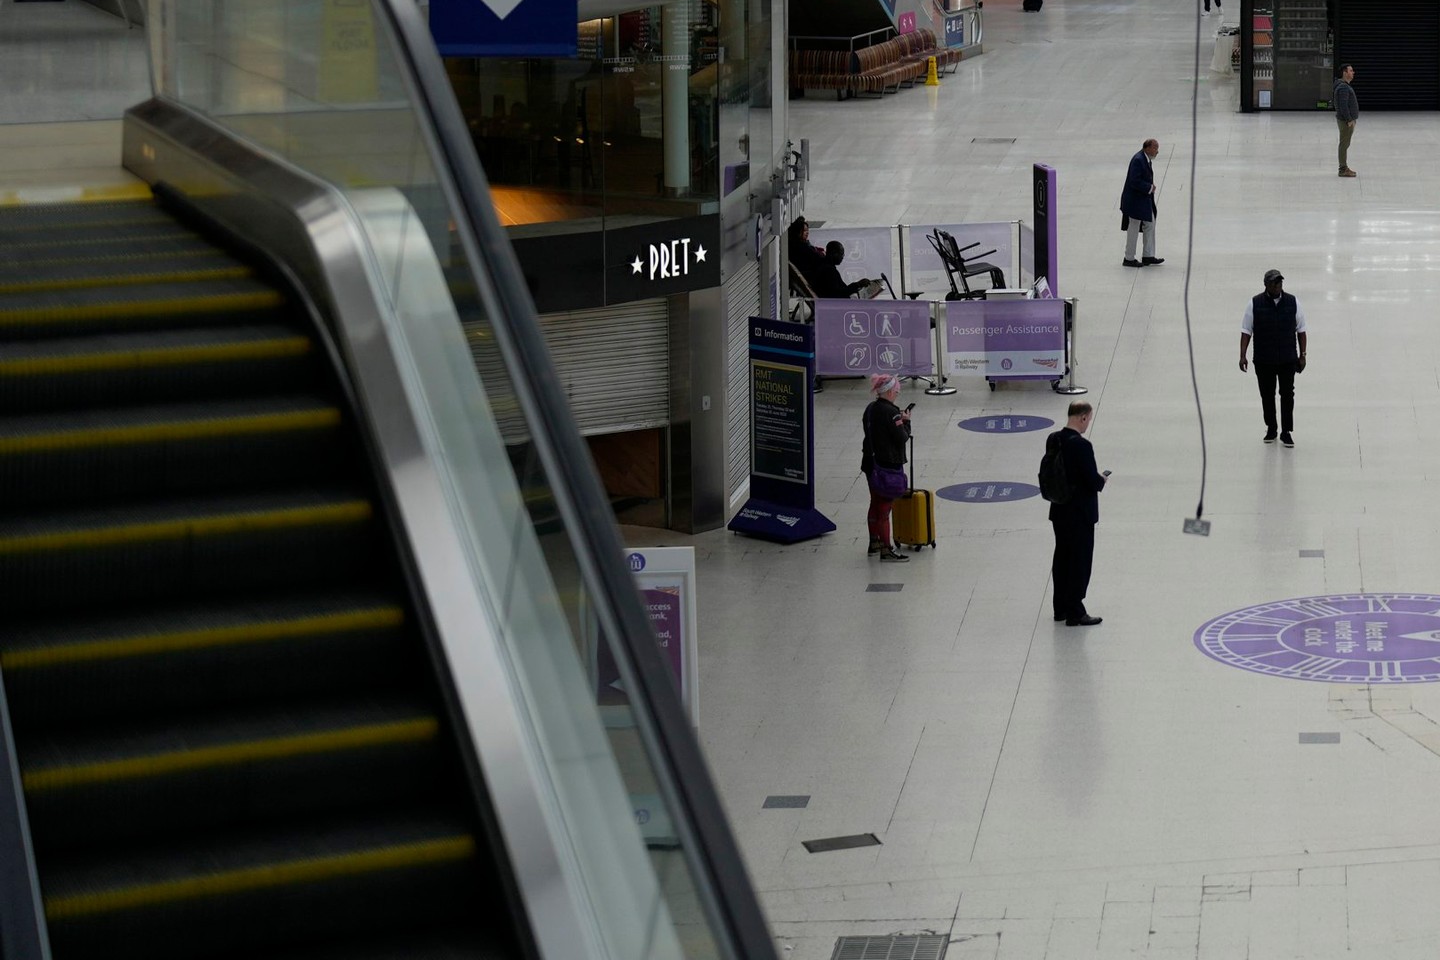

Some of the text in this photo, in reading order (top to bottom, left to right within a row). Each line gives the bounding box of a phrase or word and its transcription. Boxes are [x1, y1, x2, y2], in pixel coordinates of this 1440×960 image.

[649, 238, 691, 281] PRET
[764, 329, 803, 343] Information
[952, 324, 1060, 337] Passenger Assistance
[755, 368, 773, 380] RMT
[755, 380, 794, 395] NATIONAL
[755, 392, 788, 405] STRIKES
[1304, 627, 1328, 647] clock
[1335, 620, 1360, 654] under the
[1365, 621, 1388, 652] Meet me
